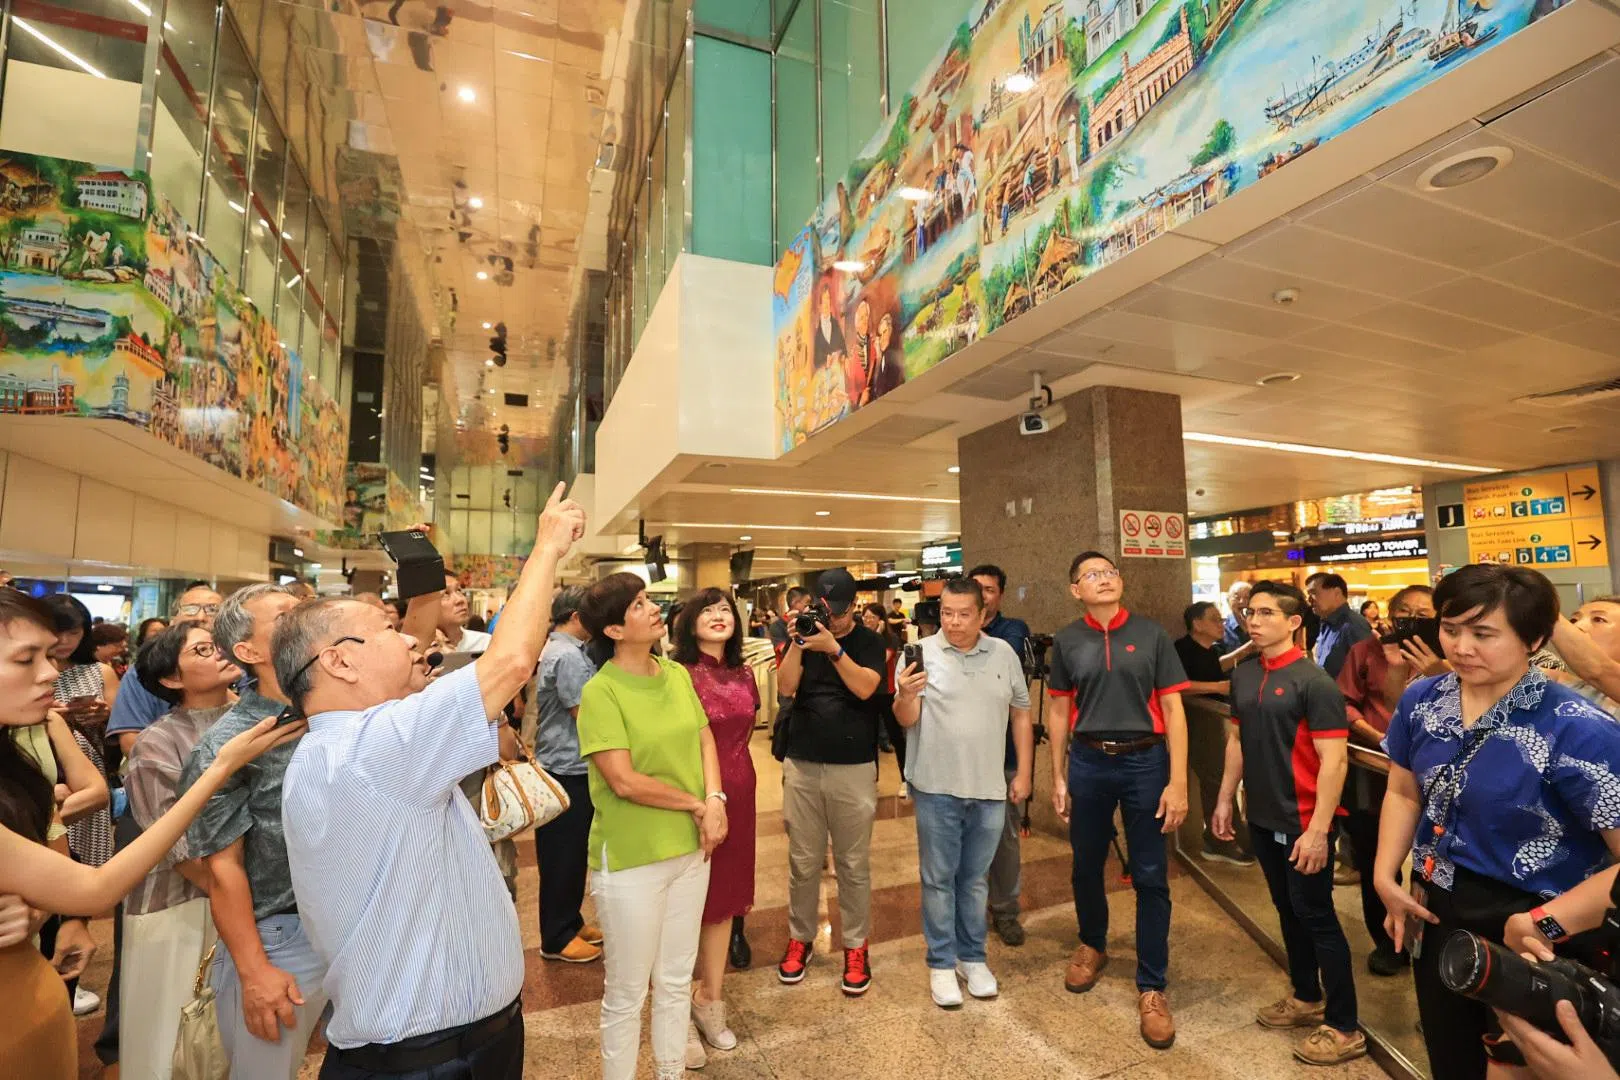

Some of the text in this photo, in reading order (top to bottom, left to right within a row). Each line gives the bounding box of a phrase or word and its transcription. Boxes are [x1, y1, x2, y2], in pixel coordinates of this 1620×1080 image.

[1515, 506, 1524, 517] C
[1536, 504, 1542, 515] 1
[1447, 507, 1455, 527] J
[1382, 539, 1419, 551] TOWER
[1520, 552, 1529, 563] D
[1540, 551, 1549, 562] 4
